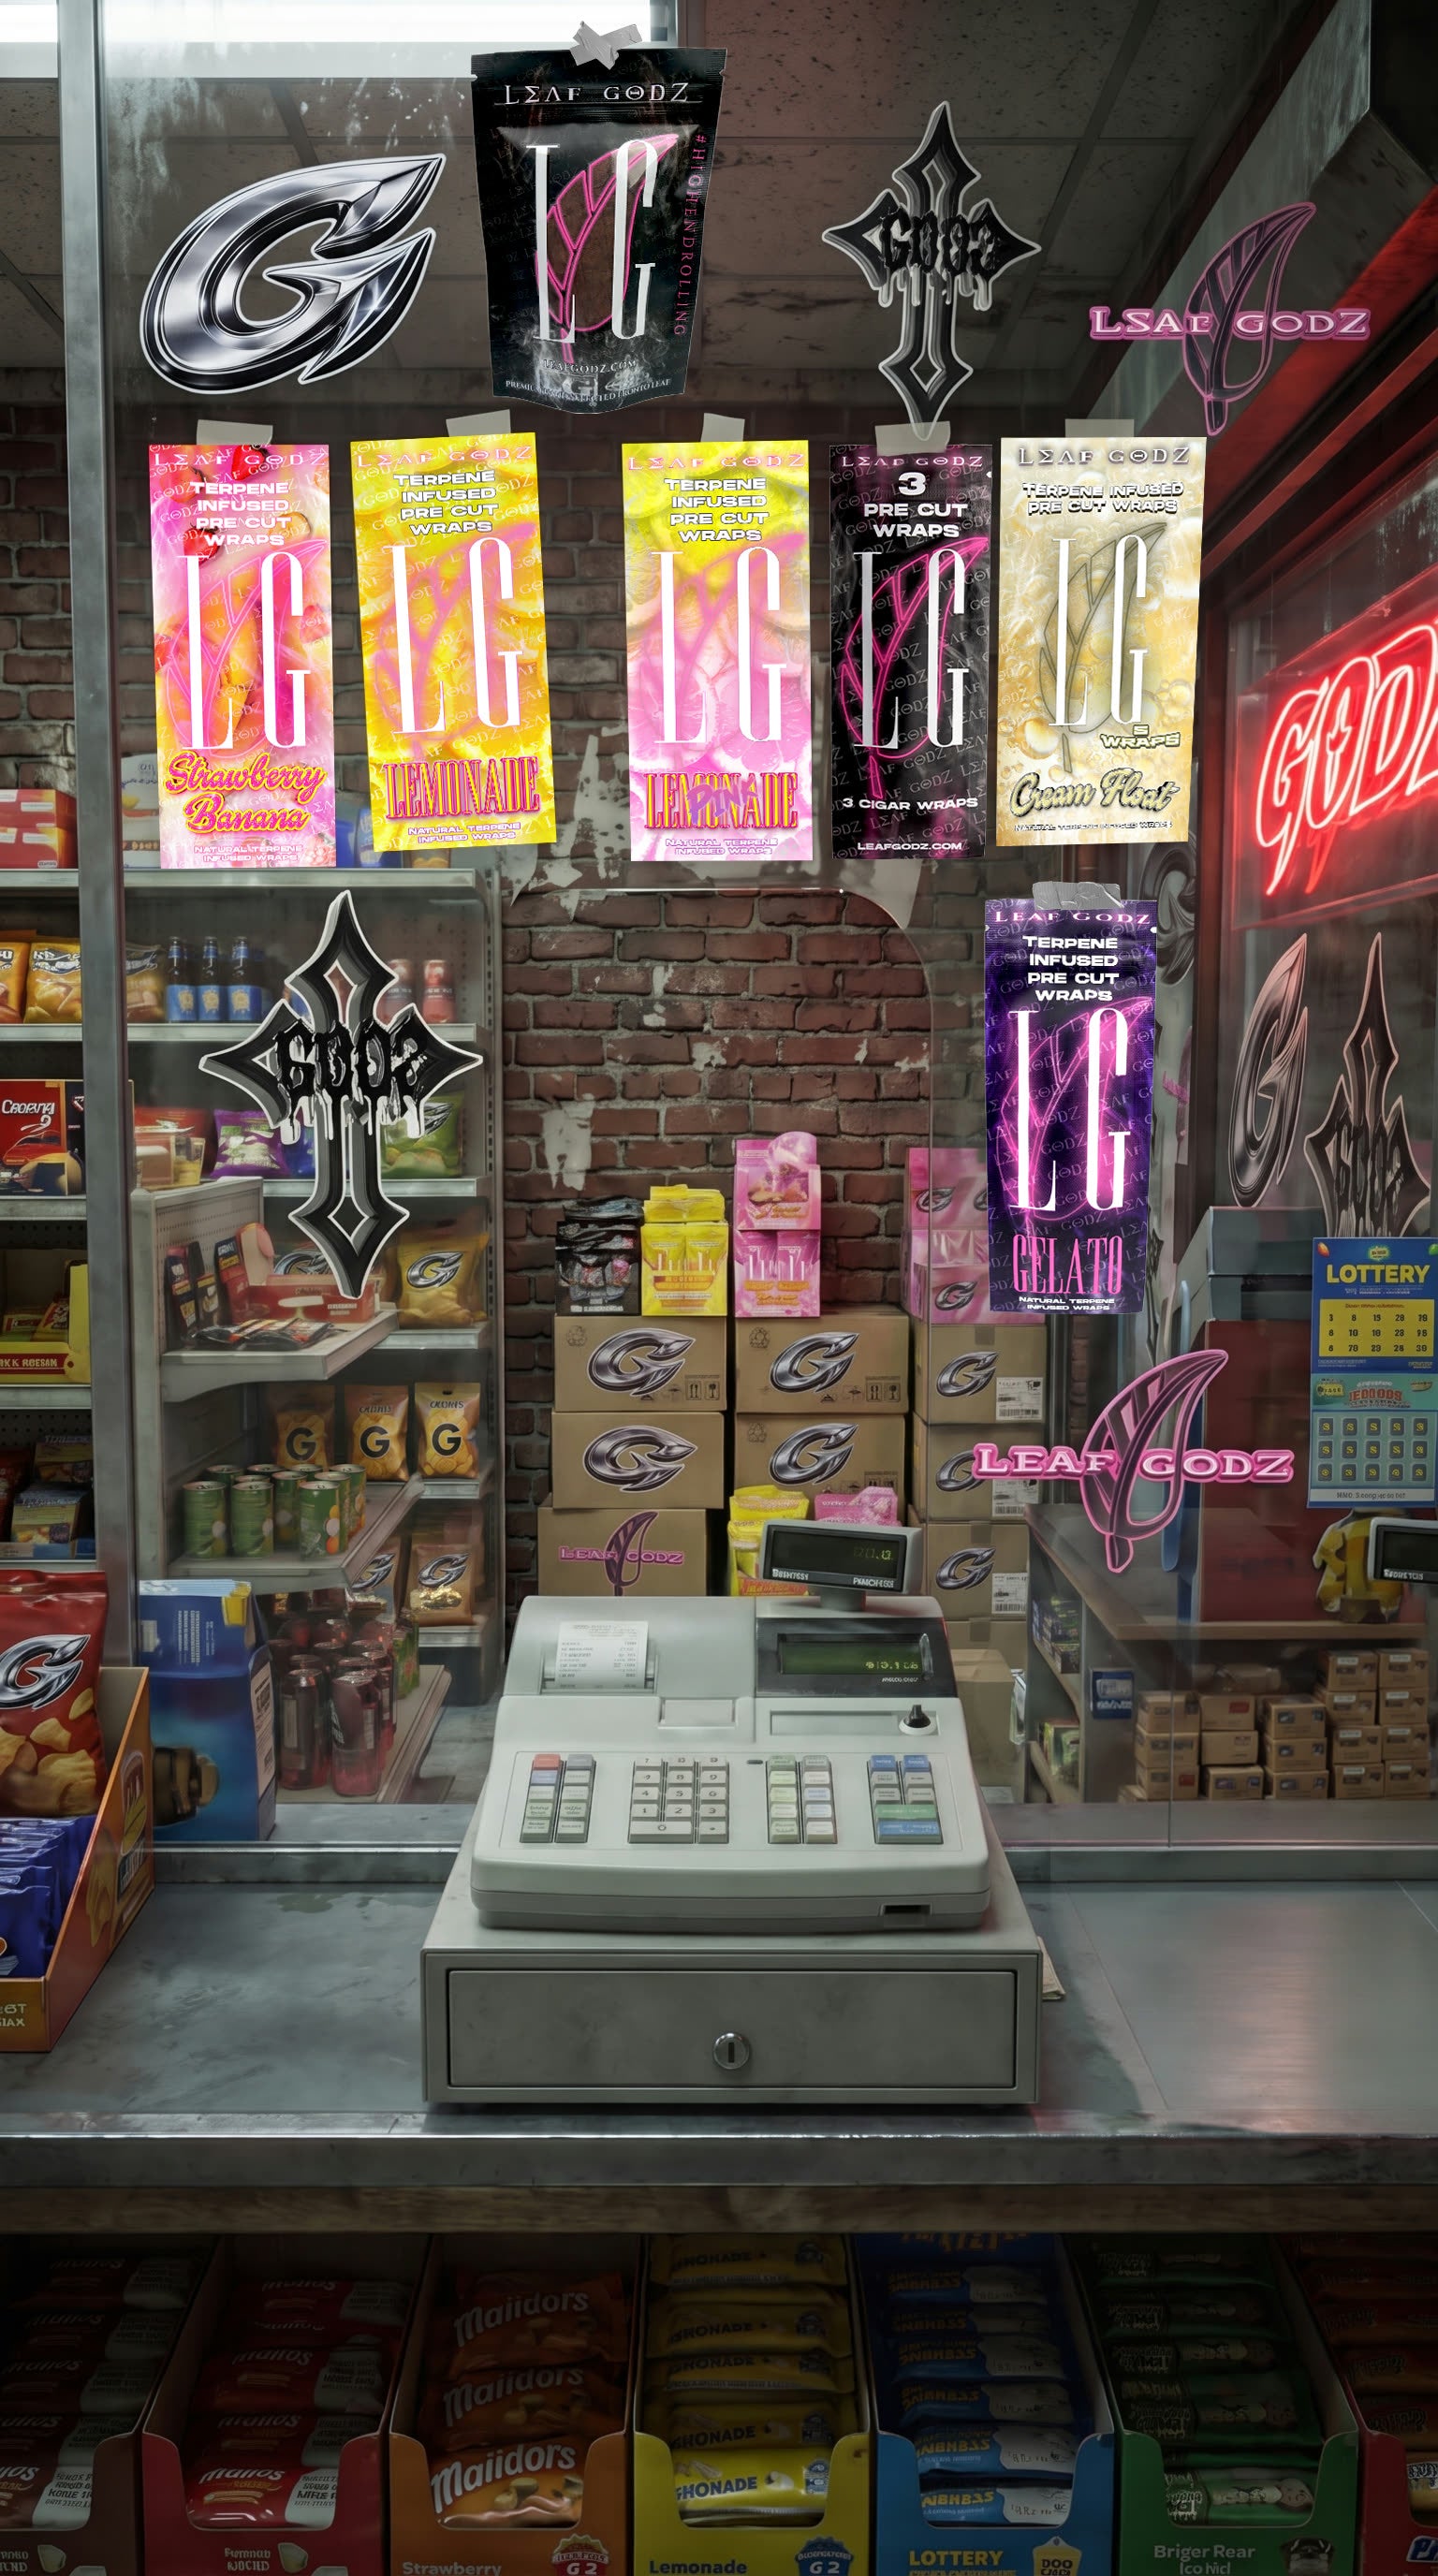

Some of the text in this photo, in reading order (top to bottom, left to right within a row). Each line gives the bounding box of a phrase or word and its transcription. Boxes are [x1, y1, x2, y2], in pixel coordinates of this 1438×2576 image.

[393, 469, 497, 488] TERPENE
[664, 477, 768, 491] TERPENE
[898, 471, 928, 497] 3
[189, 481, 290, 495] TERPENE
[401, 486, 497, 504] INFUSED
[1022, 481, 1185, 499] TERPENE INFUSED
[197, 499, 289, 512] INFUSED
[671, 494, 768, 508] INFUSED
[1028, 499, 1179, 516] PRE CUT WRAPS
[400, 503, 500, 520] PRE CUT
[670, 511, 770, 526] PRE CUT
[863, 503, 969, 519] PRE CUT
[196, 517, 292, 530] PRE CUT
[409, 520, 493, 536] WRAPS
[873, 523, 961, 538] WRAPS
[204, 534, 286, 547] WRAPS
[678, 529, 763, 543] WRAPS
[1099, 732, 1181, 749] WRAPS
[165, 749, 329, 805] Strawberry
[384, 755, 541, 820] LEMONADE
[1009, 771, 1097, 817] Cream
[843, 797, 979, 811] 3 CIGAR WRAPS
[183, 792, 313, 835] Banana
[407, 826, 464, 836] NATURAL
[857, 842, 963, 851] LEAFGODZ.COM
[1021, 935, 1119, 949] TERPENE
[1029, 953, 1119, 967] INFUSED
[1027, 972, 1120, 985] PRE CUT
[1034, 988, 1113, 1002] WRAPS
[1012, 1234, 1123, 1295] GELATO
[1326, 1264, 1431, 1284] LOTTERY
[1019, 1295, 1066, 1304] NATURAL
[286, 1427, 317, 1462] G
[360, 1425, 390, 1459] G
[432, 1422, 462, 1457] G
[976, 1446, 1293, 1479] LEAF GODZ
[908, 2550, 1005, 2567] LOTTERY
[1153, 2544, 1256, 2563] Briger Rear
[402, 2561, 503, 2576] Strawberry
[649, 2559, 748, 2575] Lemonade
[828, 2561, 841, 2575] 2
